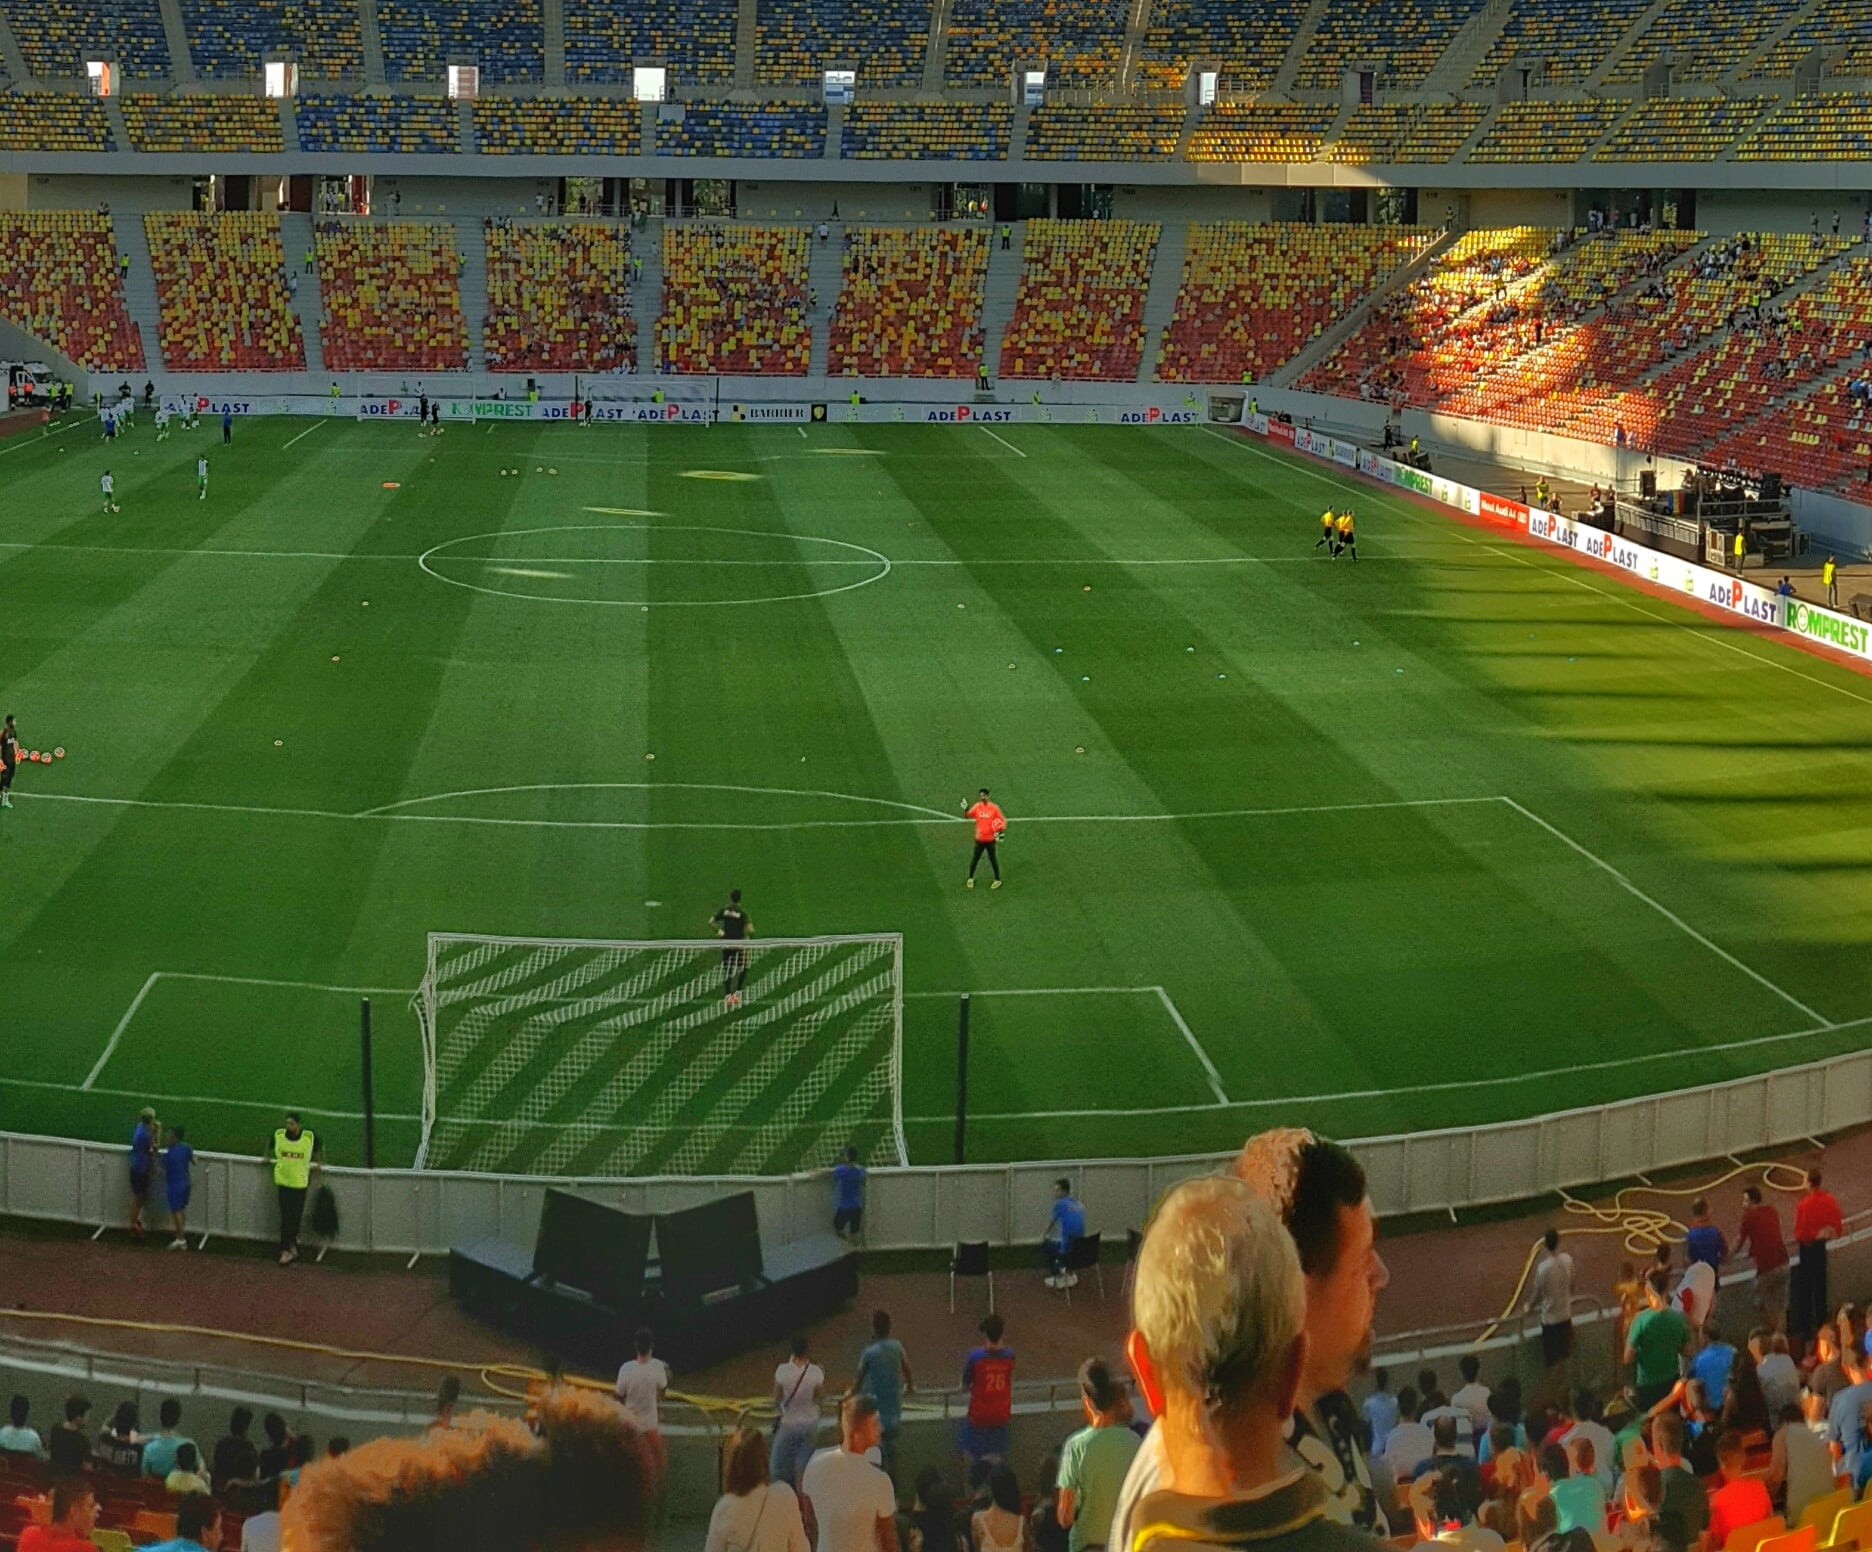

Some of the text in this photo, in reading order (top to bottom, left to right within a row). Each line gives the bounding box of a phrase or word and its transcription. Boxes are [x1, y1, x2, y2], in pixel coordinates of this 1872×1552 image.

[928, 406, 1011, 421] ADEPLAST
[1532, 513, 1579, 547] ADEPLAST
[1586, 534, 1638, 569] ADEPLAST
[1710, 580, 1777, 623] ADEPLAST
[1787, 601, 1869, 653] ROMPREST
[985, 1373, 1006, 1392] 26
